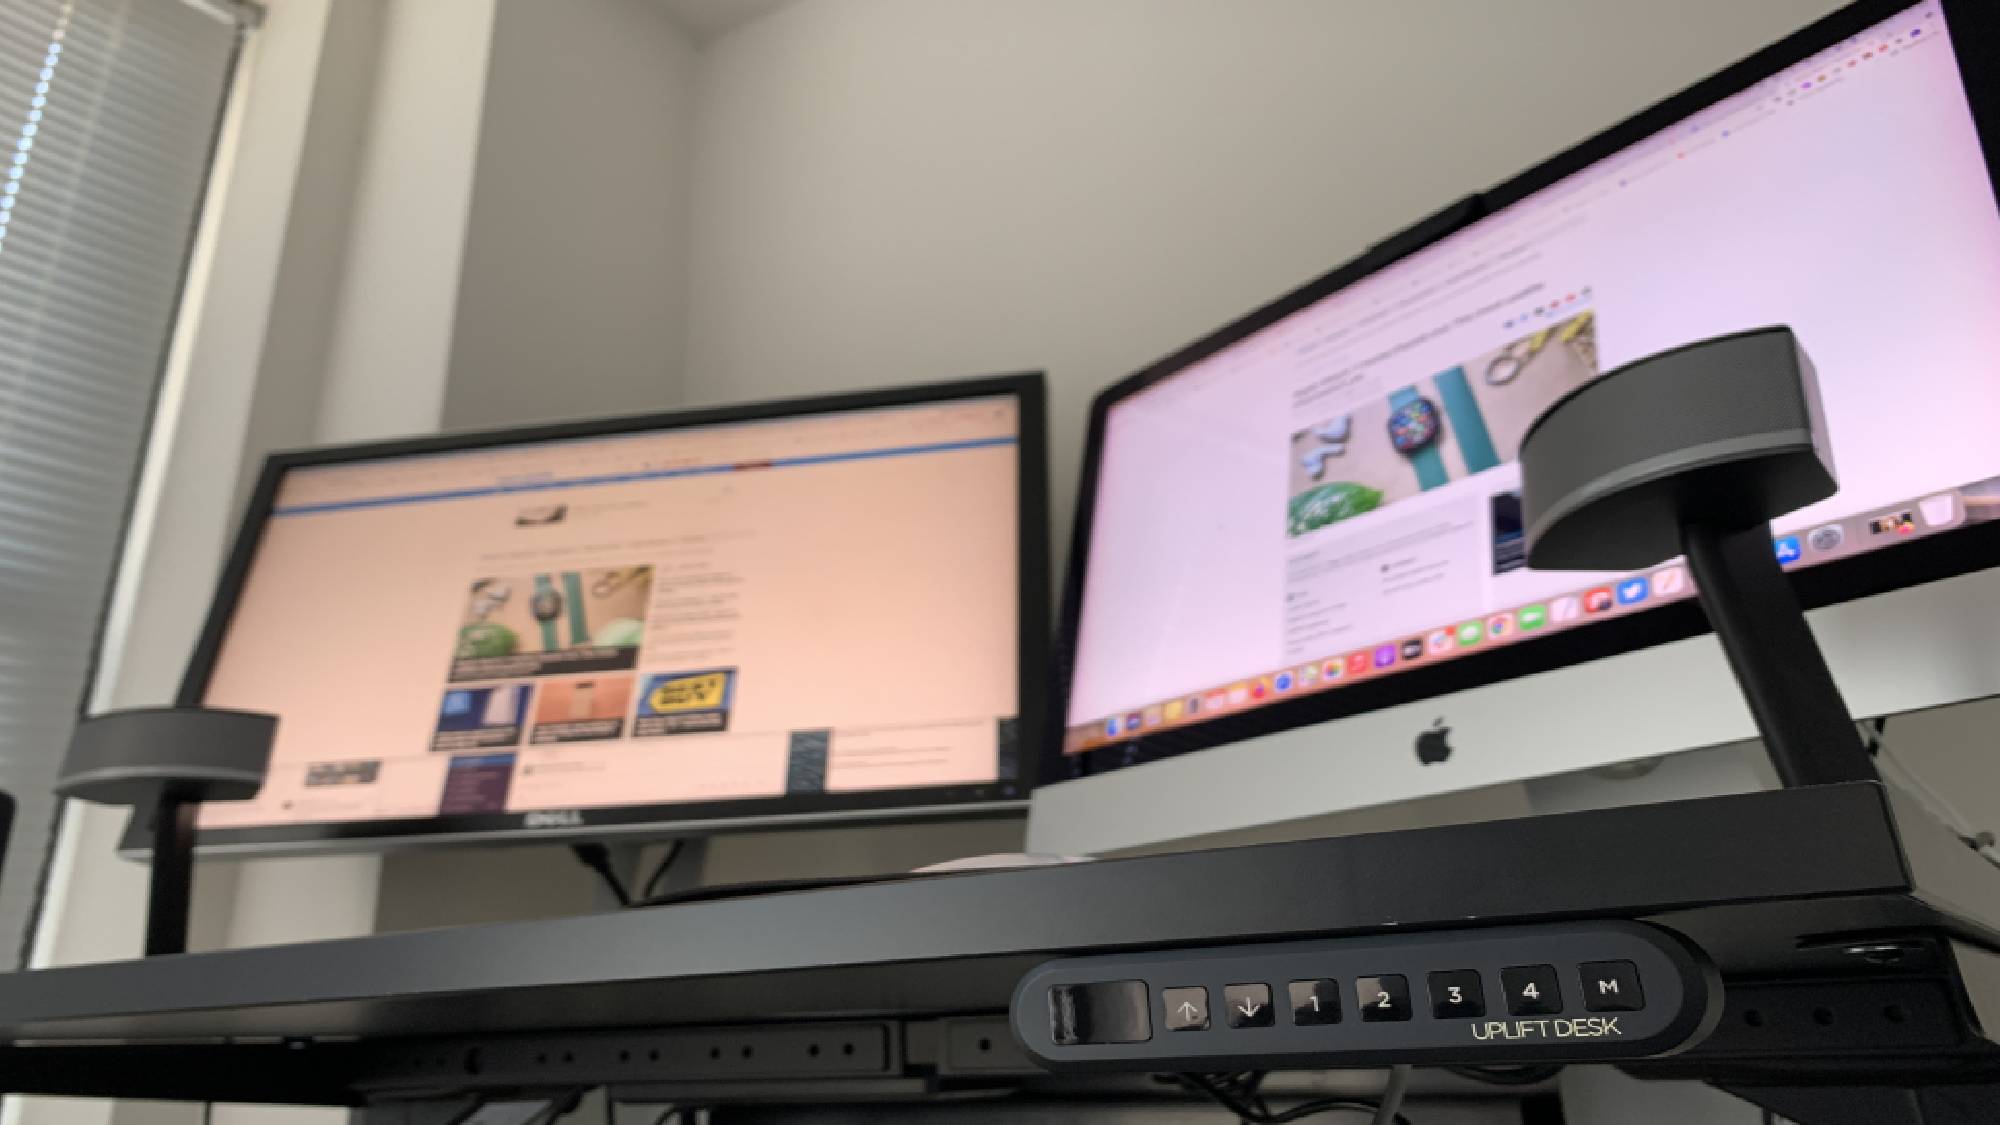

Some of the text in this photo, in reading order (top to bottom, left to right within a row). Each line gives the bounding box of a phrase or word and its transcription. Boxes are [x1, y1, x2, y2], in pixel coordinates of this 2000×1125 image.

[1308, 978, 1620, 1012] 1 2 3 4 M
[1471, 1017, 1622, 1040] UPLIFT DESK
